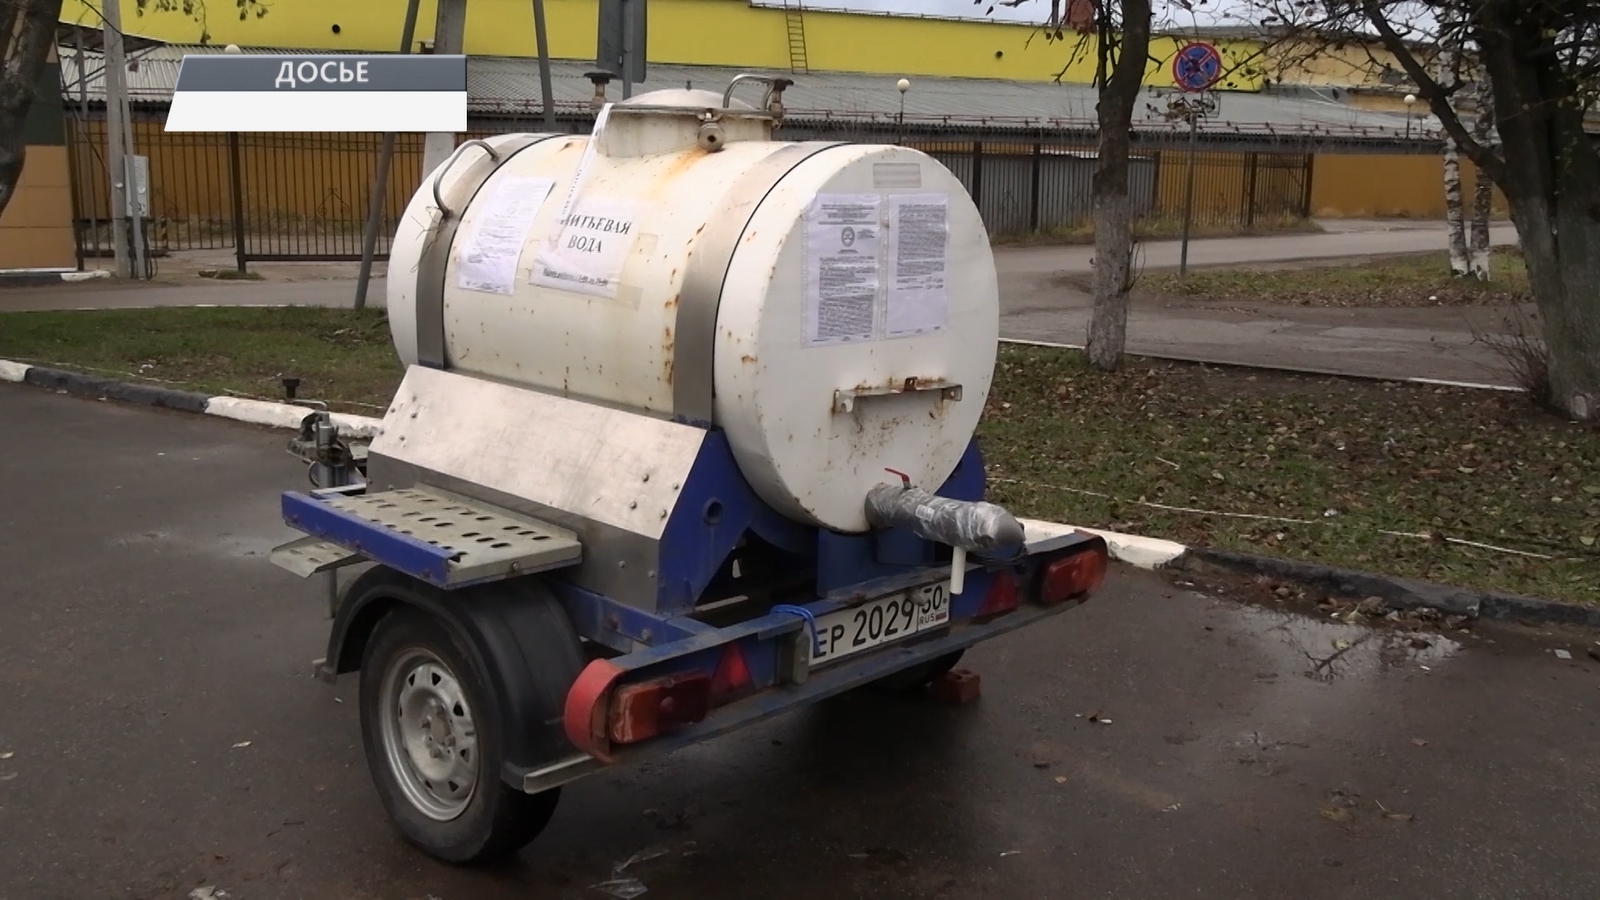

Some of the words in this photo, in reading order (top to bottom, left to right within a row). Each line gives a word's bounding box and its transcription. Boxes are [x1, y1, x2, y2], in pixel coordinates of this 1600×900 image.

[567, 235, 602, 253] ВОДА
[853, 600, 914, 647] 2029
[919, 612, 936, 625] RUS
